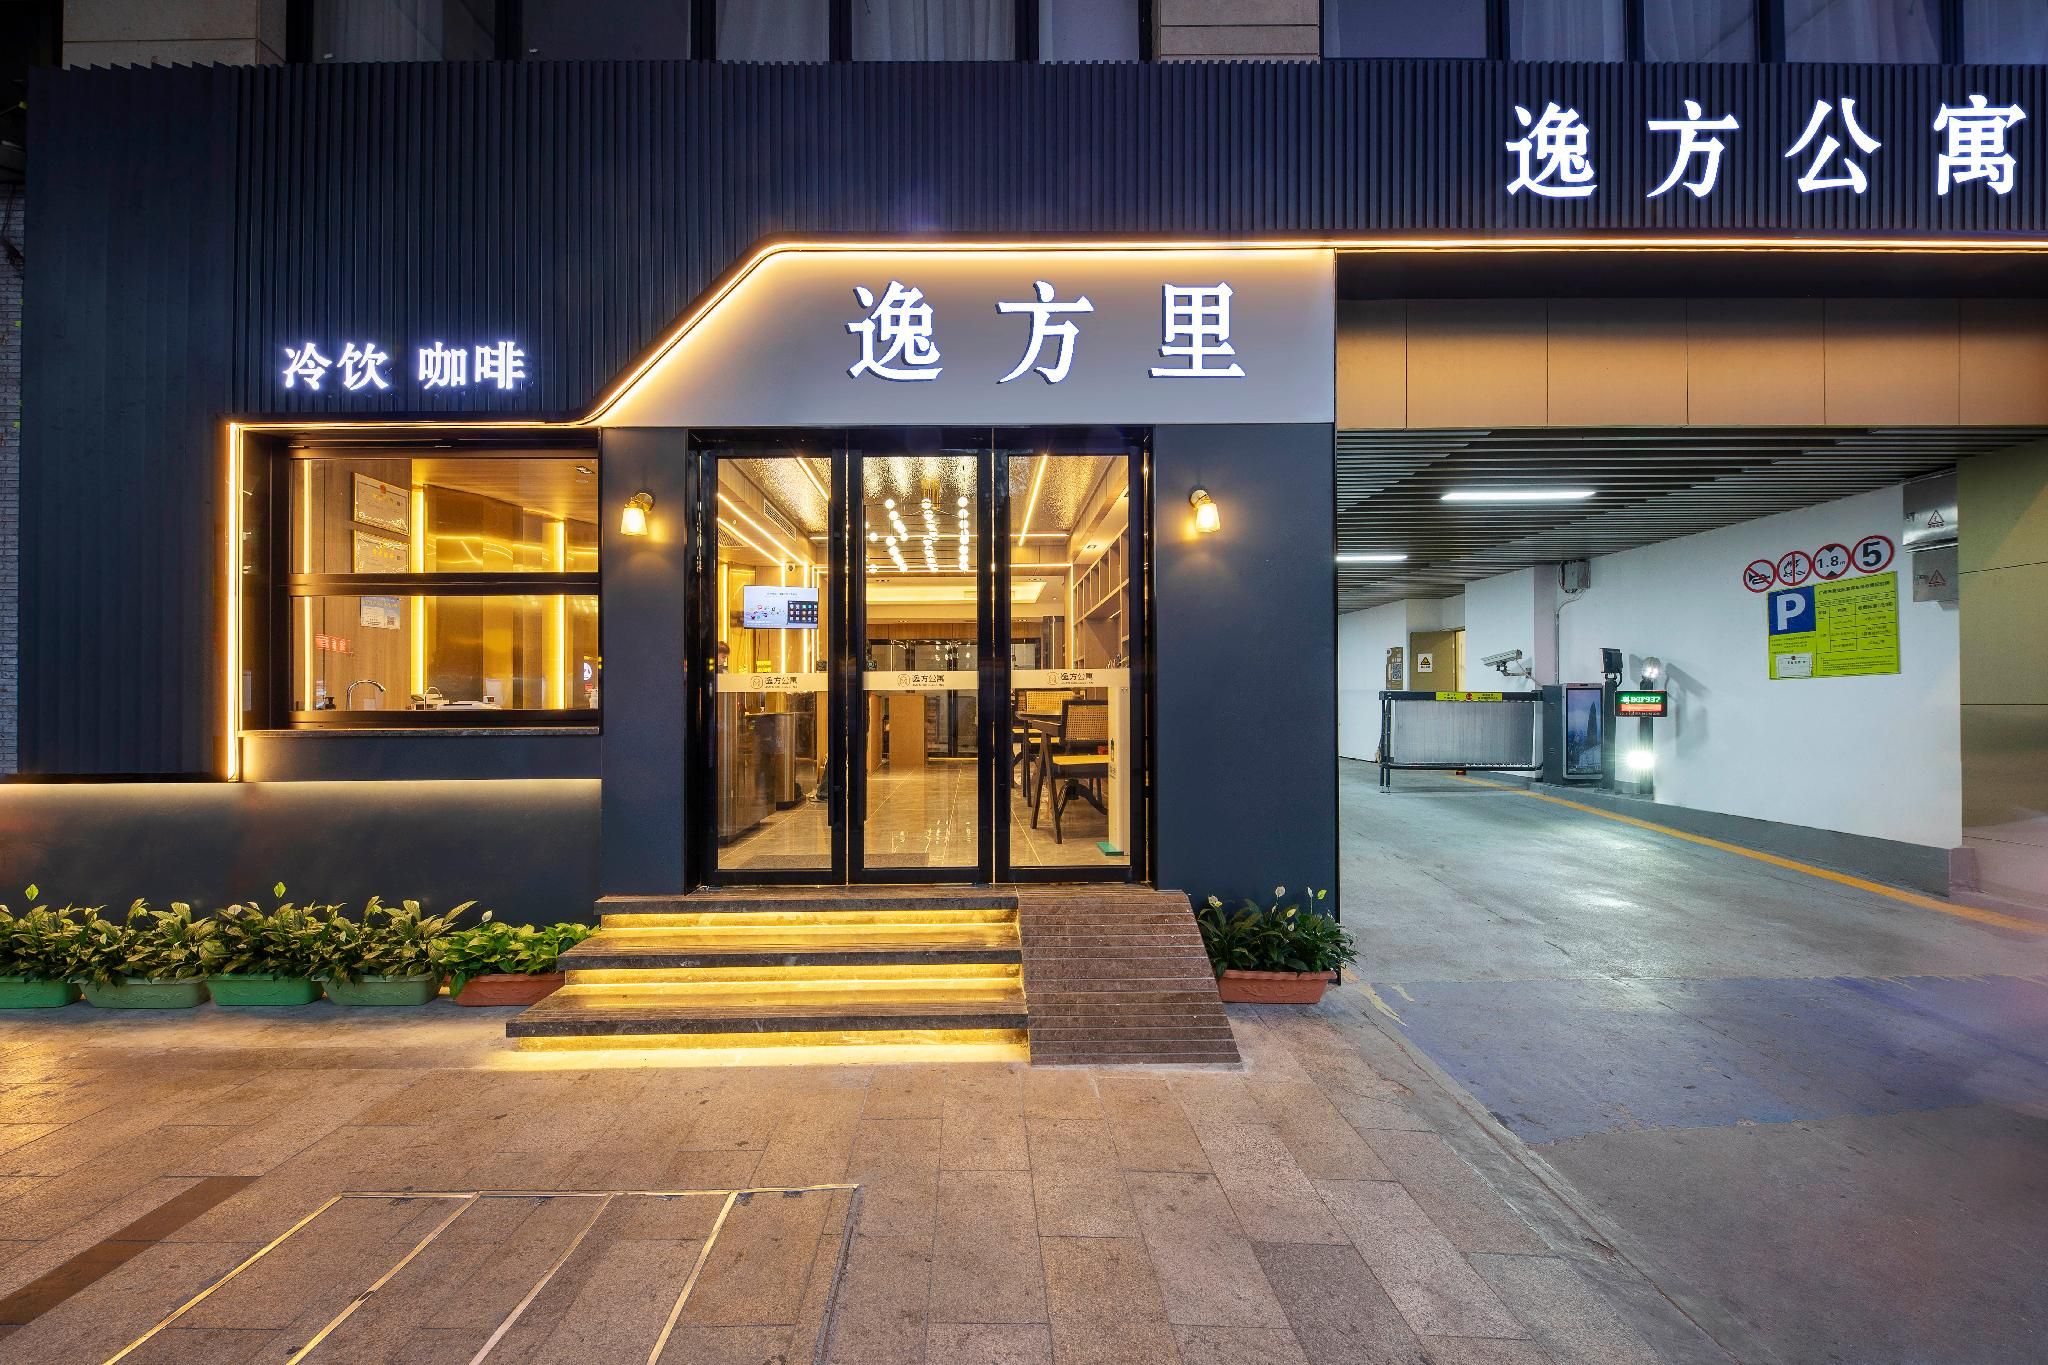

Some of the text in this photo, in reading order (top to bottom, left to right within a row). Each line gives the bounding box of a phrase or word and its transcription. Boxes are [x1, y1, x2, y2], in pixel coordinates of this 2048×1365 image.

[1505, 94, 2026, 198] 逸方公寓
[845, 280, 1246, 384] 逸方里
[284, 341, 525, 390] 冷饮 咖啡
[1862, 541, 1882, 567] 5
[1776, 593, 1806, 631] P
